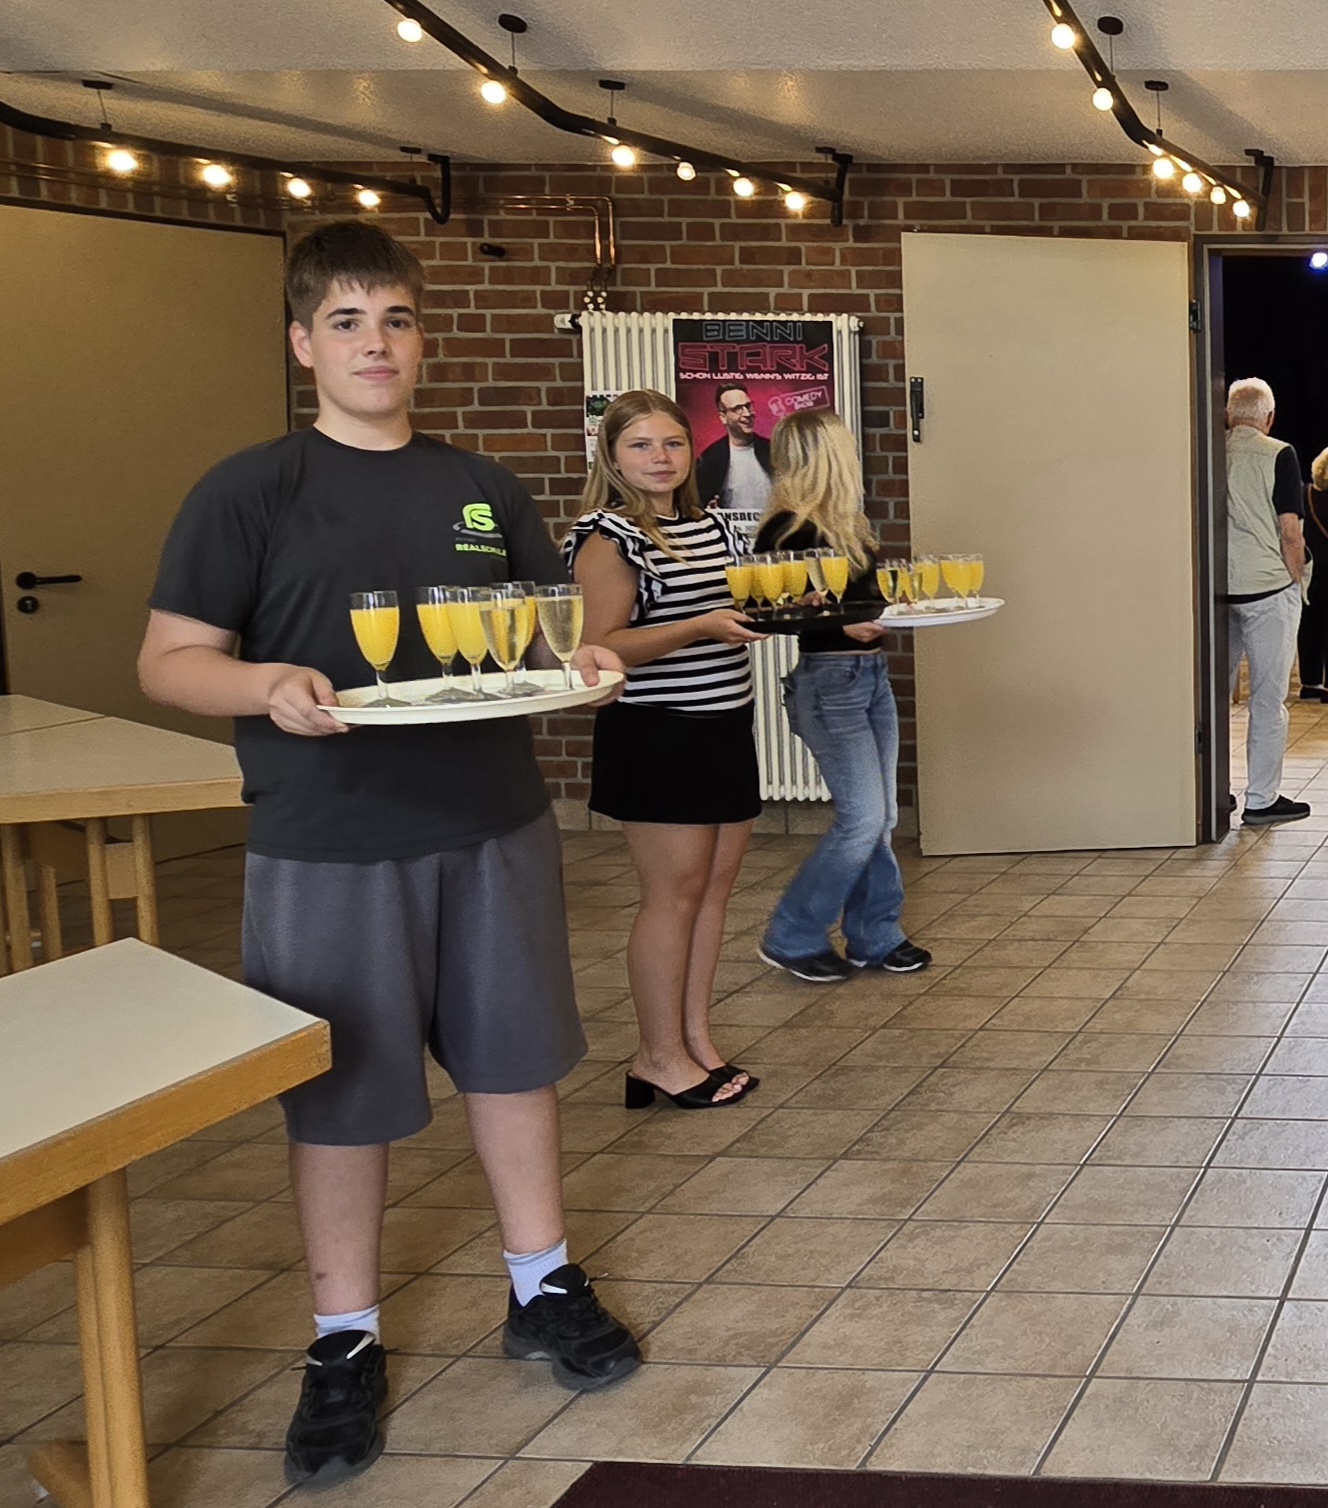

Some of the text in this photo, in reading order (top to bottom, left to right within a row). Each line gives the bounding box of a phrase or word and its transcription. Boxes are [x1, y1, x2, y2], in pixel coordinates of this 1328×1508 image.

[702, 321, 803, 341] BENNI
[678, 342, 829, 371] STARK
[785, 391, 822, 406] COMEDY
